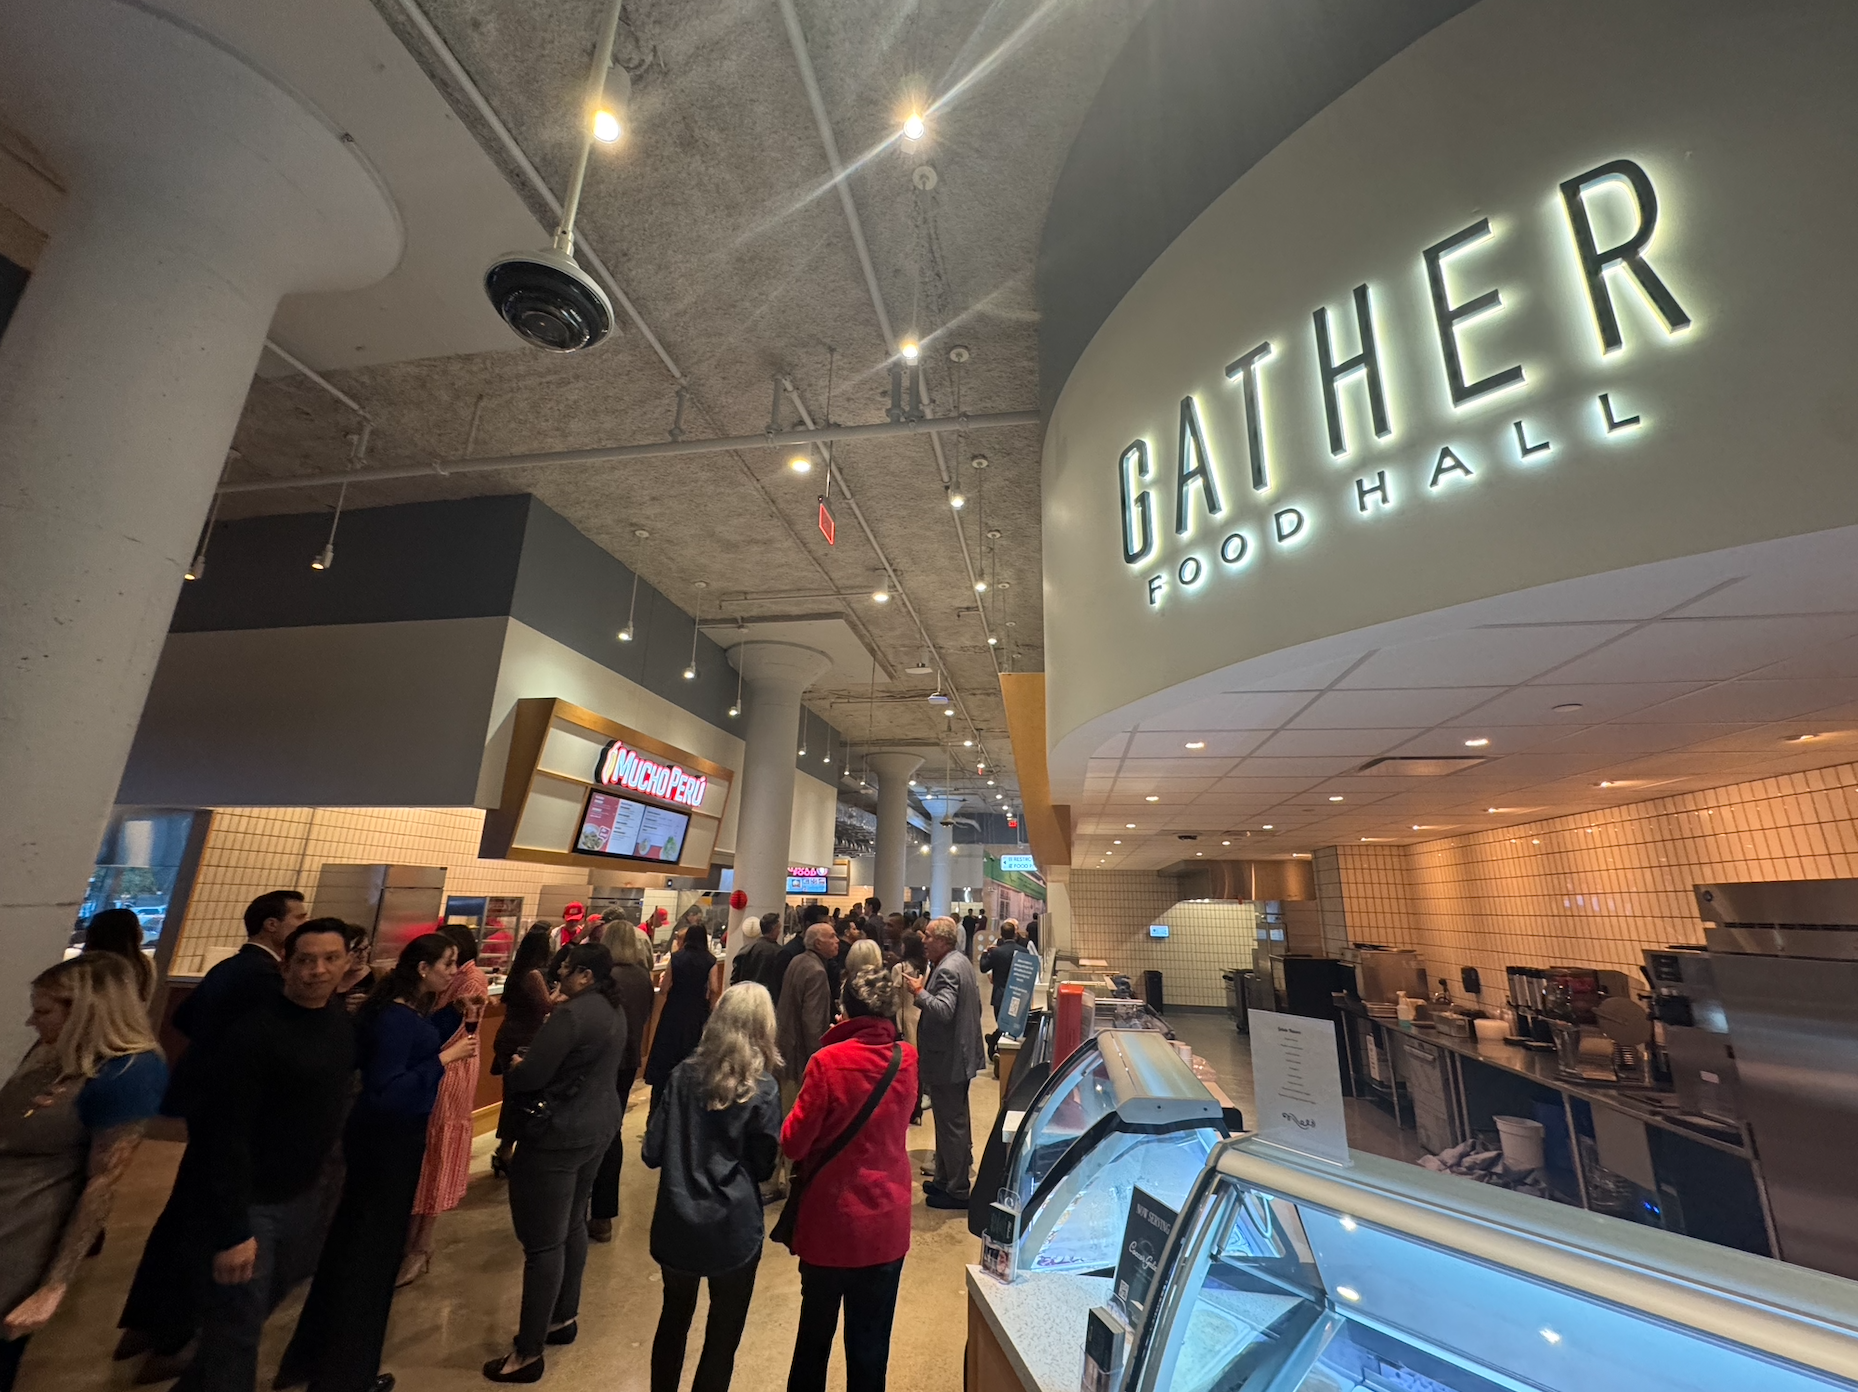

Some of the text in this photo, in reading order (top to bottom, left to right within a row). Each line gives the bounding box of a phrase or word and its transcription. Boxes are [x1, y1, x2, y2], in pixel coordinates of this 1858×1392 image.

[1118, 159, 1692, 565] GATHER
[1148, 393, 1641, 605] FOOD HALL
[1148, 1212, 1171, 1235] SERVING
